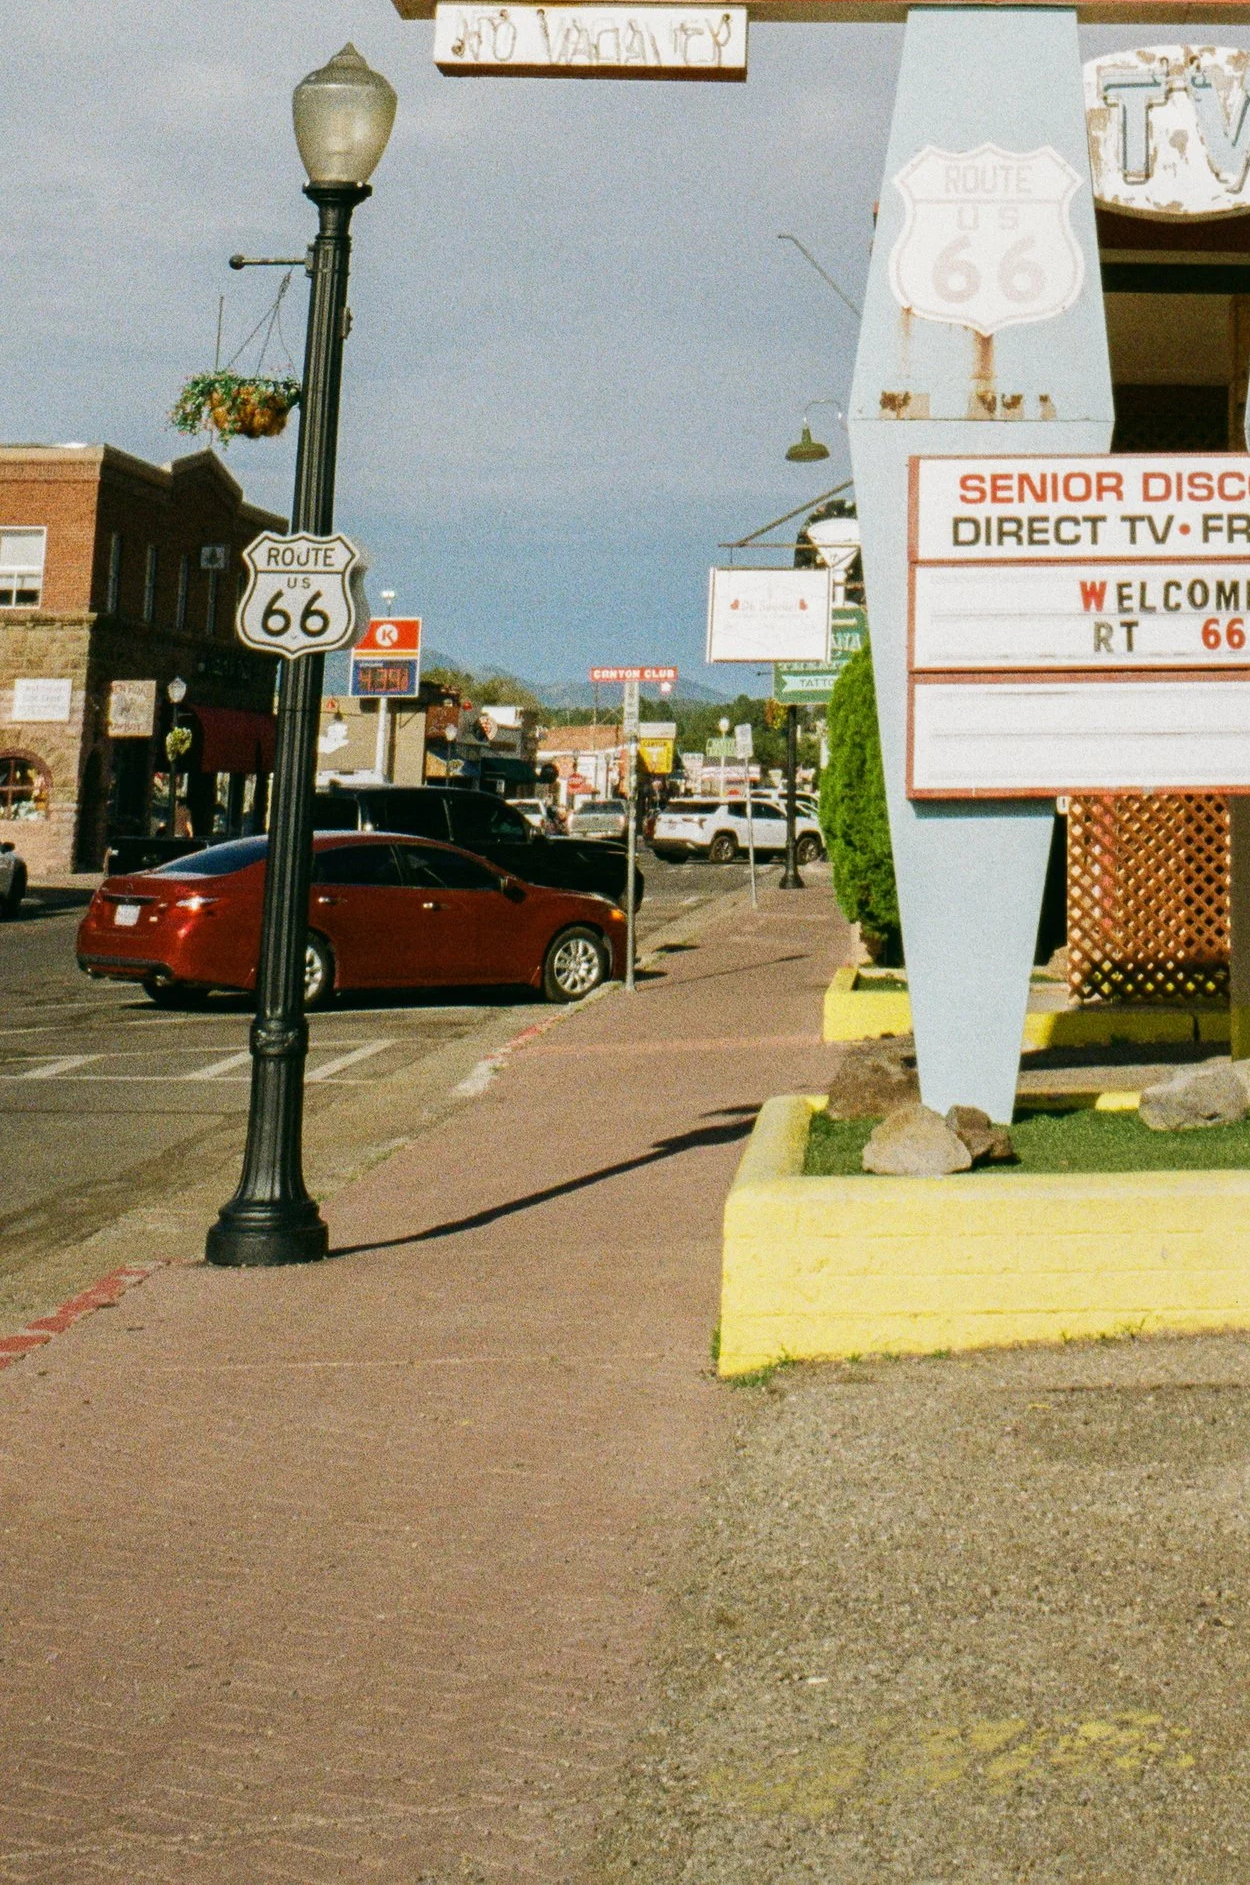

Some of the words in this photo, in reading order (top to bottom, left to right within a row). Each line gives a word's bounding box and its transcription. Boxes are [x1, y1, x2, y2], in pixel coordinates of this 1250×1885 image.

[944, 165, 1032, 195] ROUTE
[957, 206, 1019, 231] US
[932, 235, 1047, 304] 66
[958, 471, 1125, 504] SENIOR
[951, 514, 1107, 547] DIRECT
[1120, 514, 1175, 545] TV
[266, 547, 336, 567] ROUTE
[286, 577, 311, 589] US
[261, 589, 330, 638] 66
[1093, 620, 1140, 653] RT
[1200, 618, 1247, 651] 66
[593, 669, 640, 679] CANYON
[644, 668, 675, 679] CLUB
[800, 678, 834, 687] TATTO
